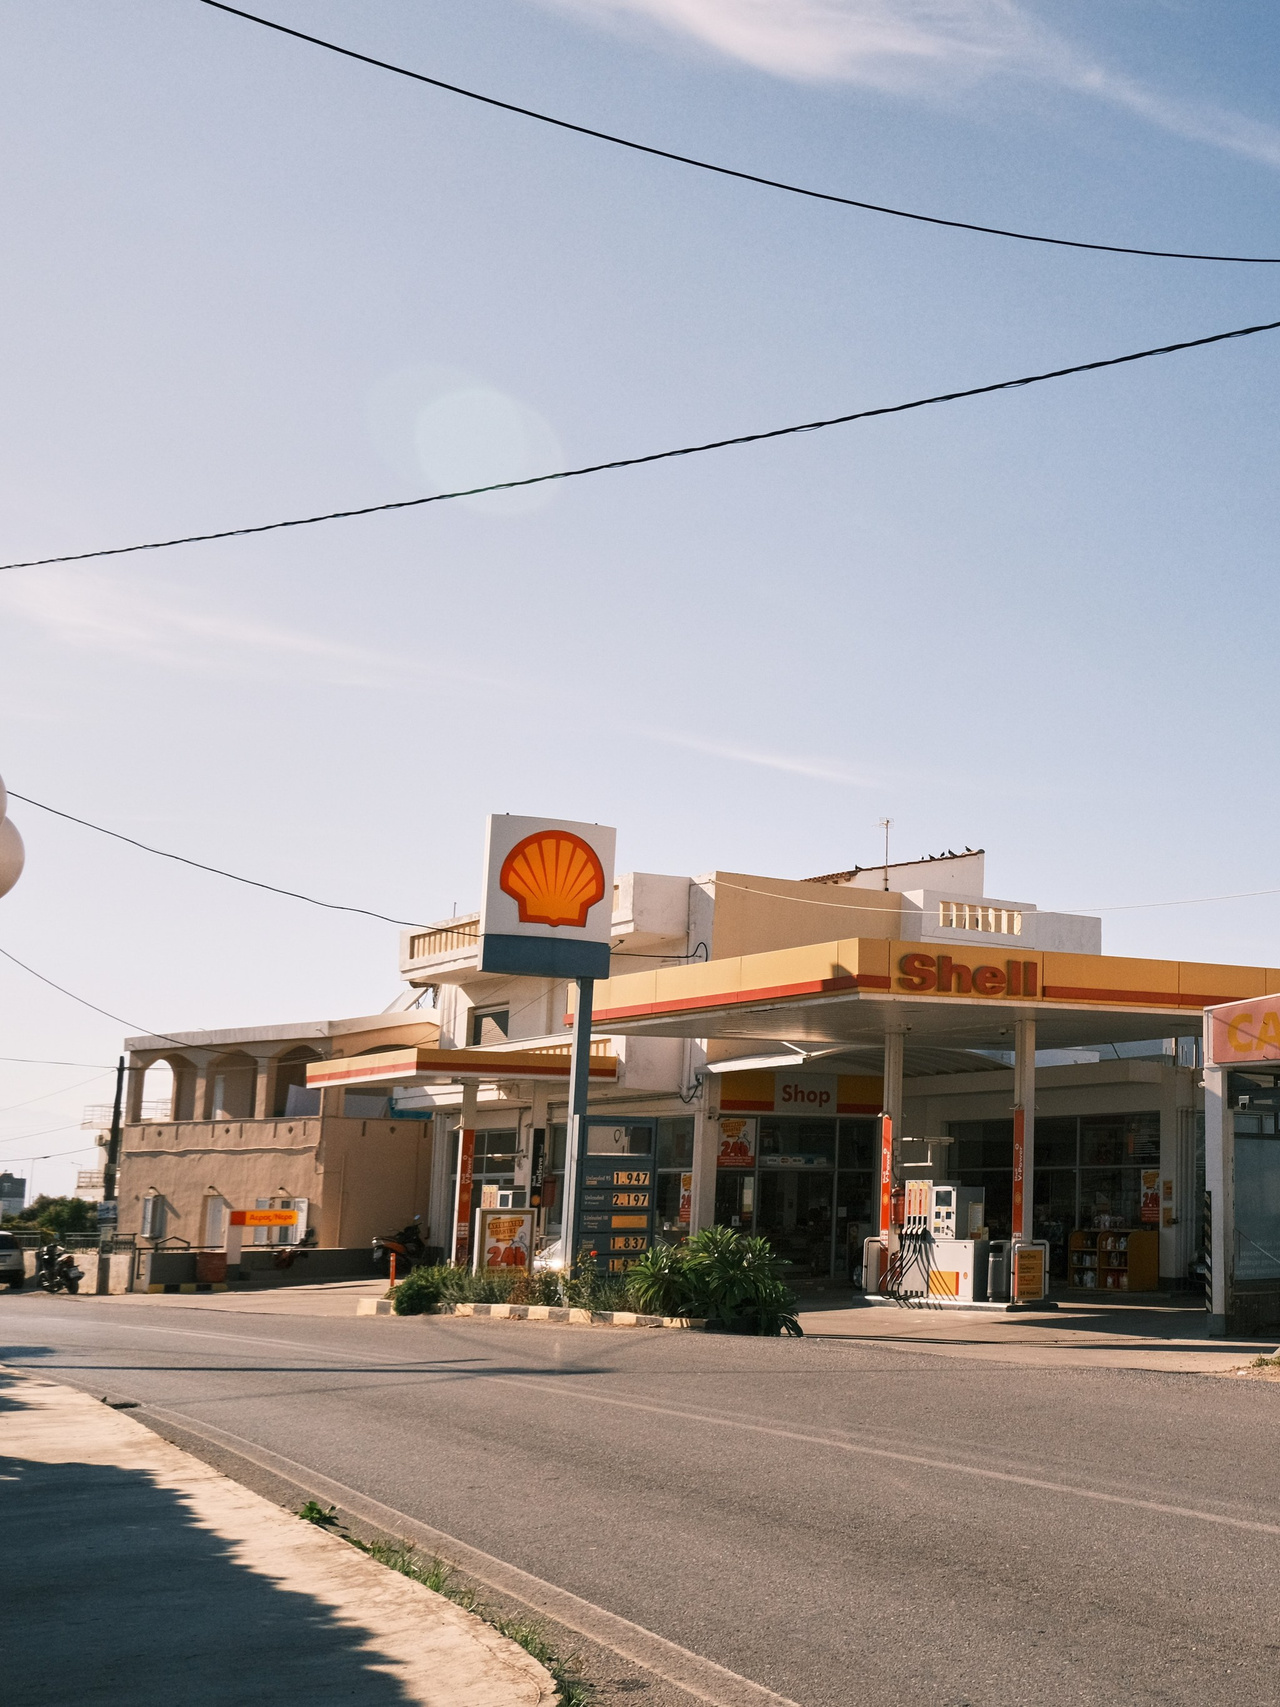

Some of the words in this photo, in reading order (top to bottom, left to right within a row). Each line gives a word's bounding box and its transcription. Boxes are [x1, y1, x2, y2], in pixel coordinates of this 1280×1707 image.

[898, 953, 1038, 997] Shell
[782, 1084, 831, 1108] Shop
[615, 1172, 649, 1185] 1.947
[613, 1194, 648, 1206] 2.197
[611, 1237, 646, 1249] 1.837
[487, 1245, 526, 1267] 24h
